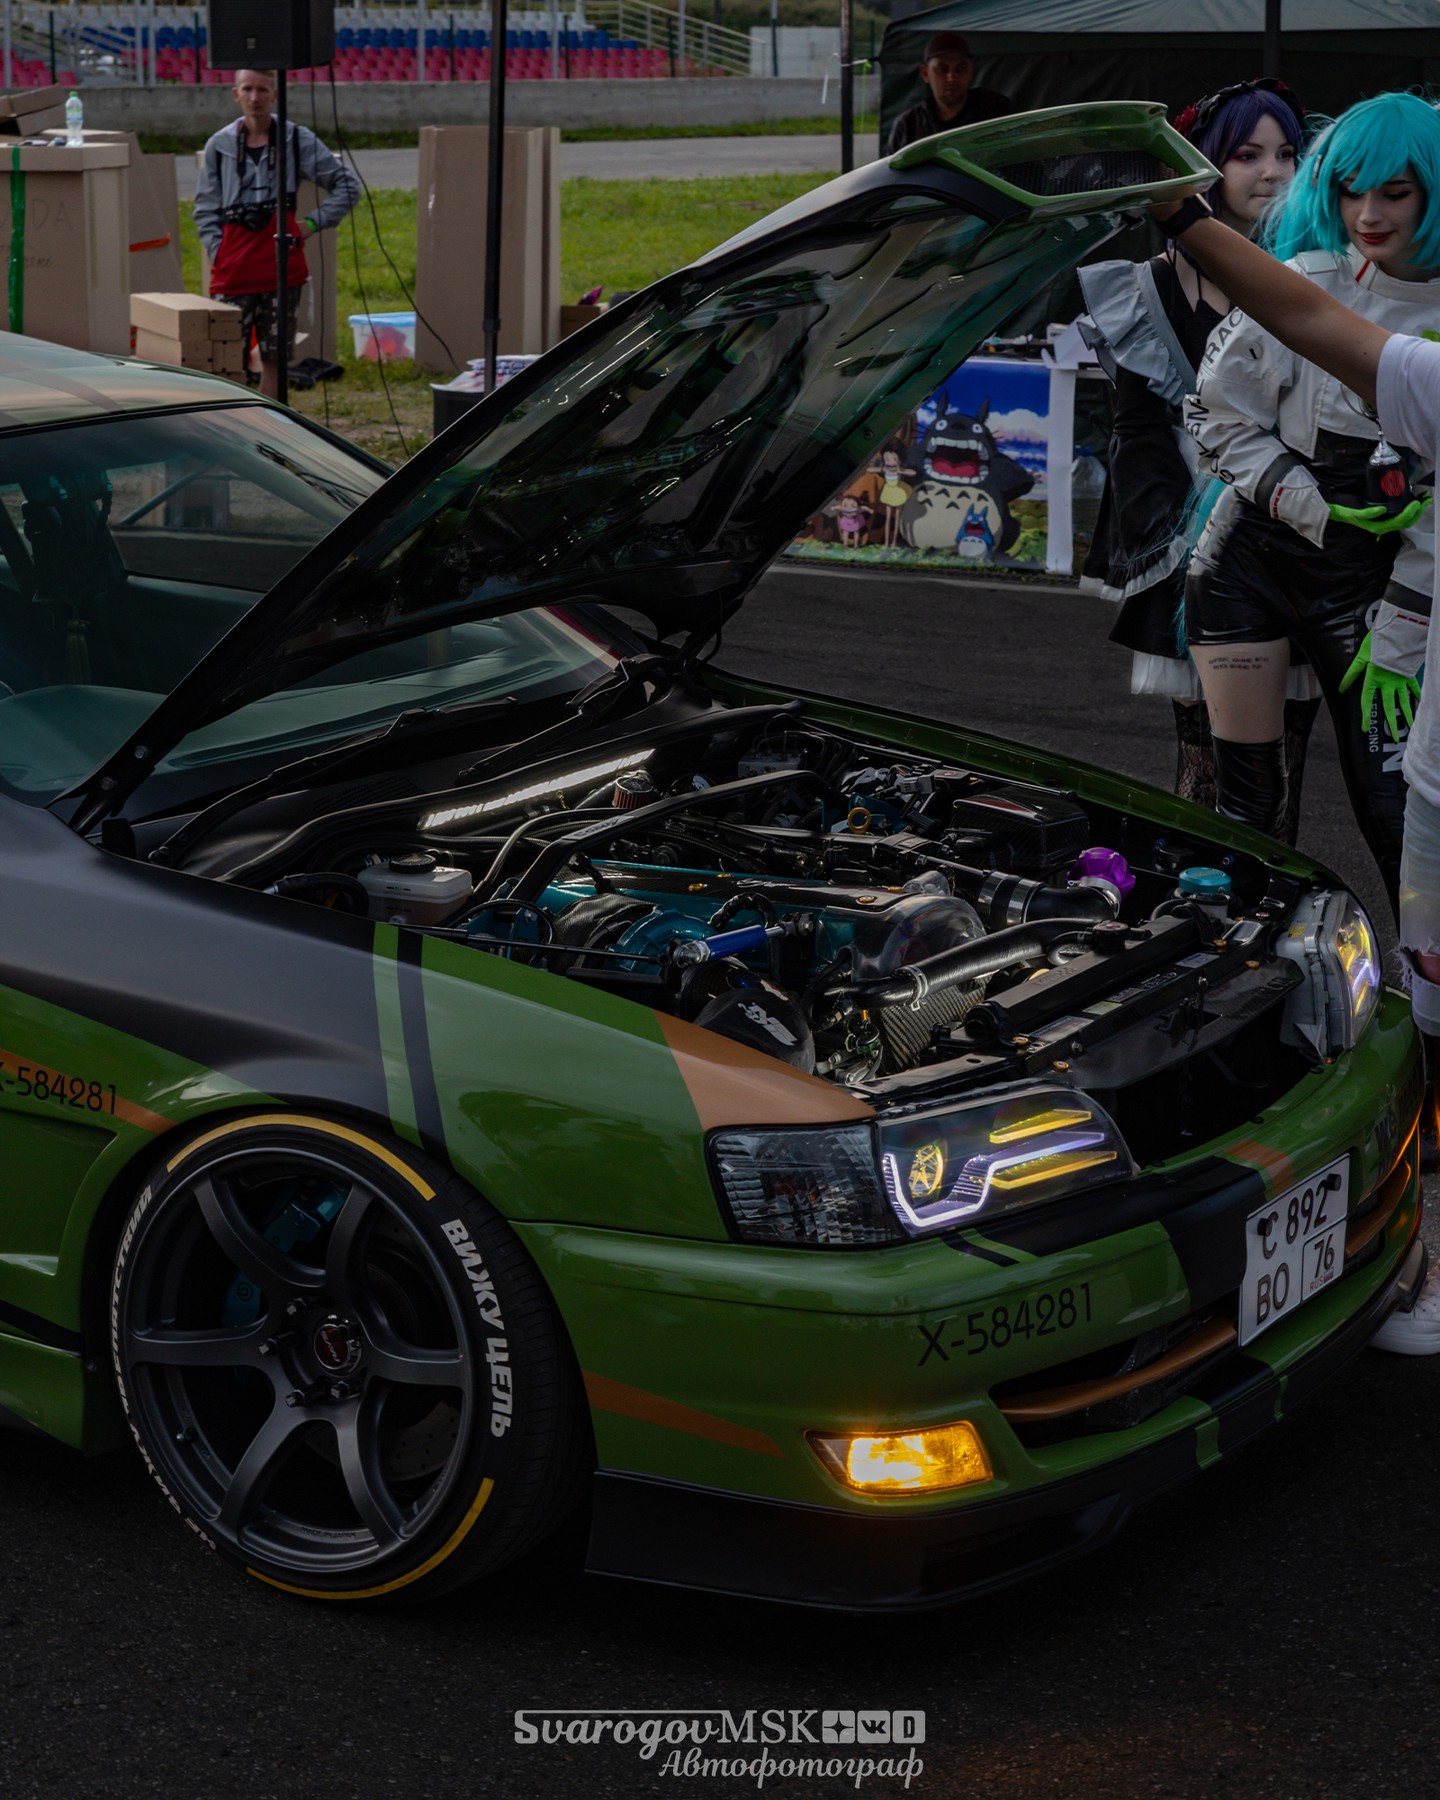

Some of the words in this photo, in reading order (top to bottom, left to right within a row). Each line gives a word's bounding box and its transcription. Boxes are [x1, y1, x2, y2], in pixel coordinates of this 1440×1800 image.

[1285, 1179, 1331, 1245] 892
[1309, 1278, 1324, 1292] RUS
[1314, 1233, 1335, 1278] 76
[440, 1218, 505, 1331] ВИЖУ
[485, 1337, 513, 1438] ЦЕЛЬ
[917, 1282, 1092, 1367] X-584281
